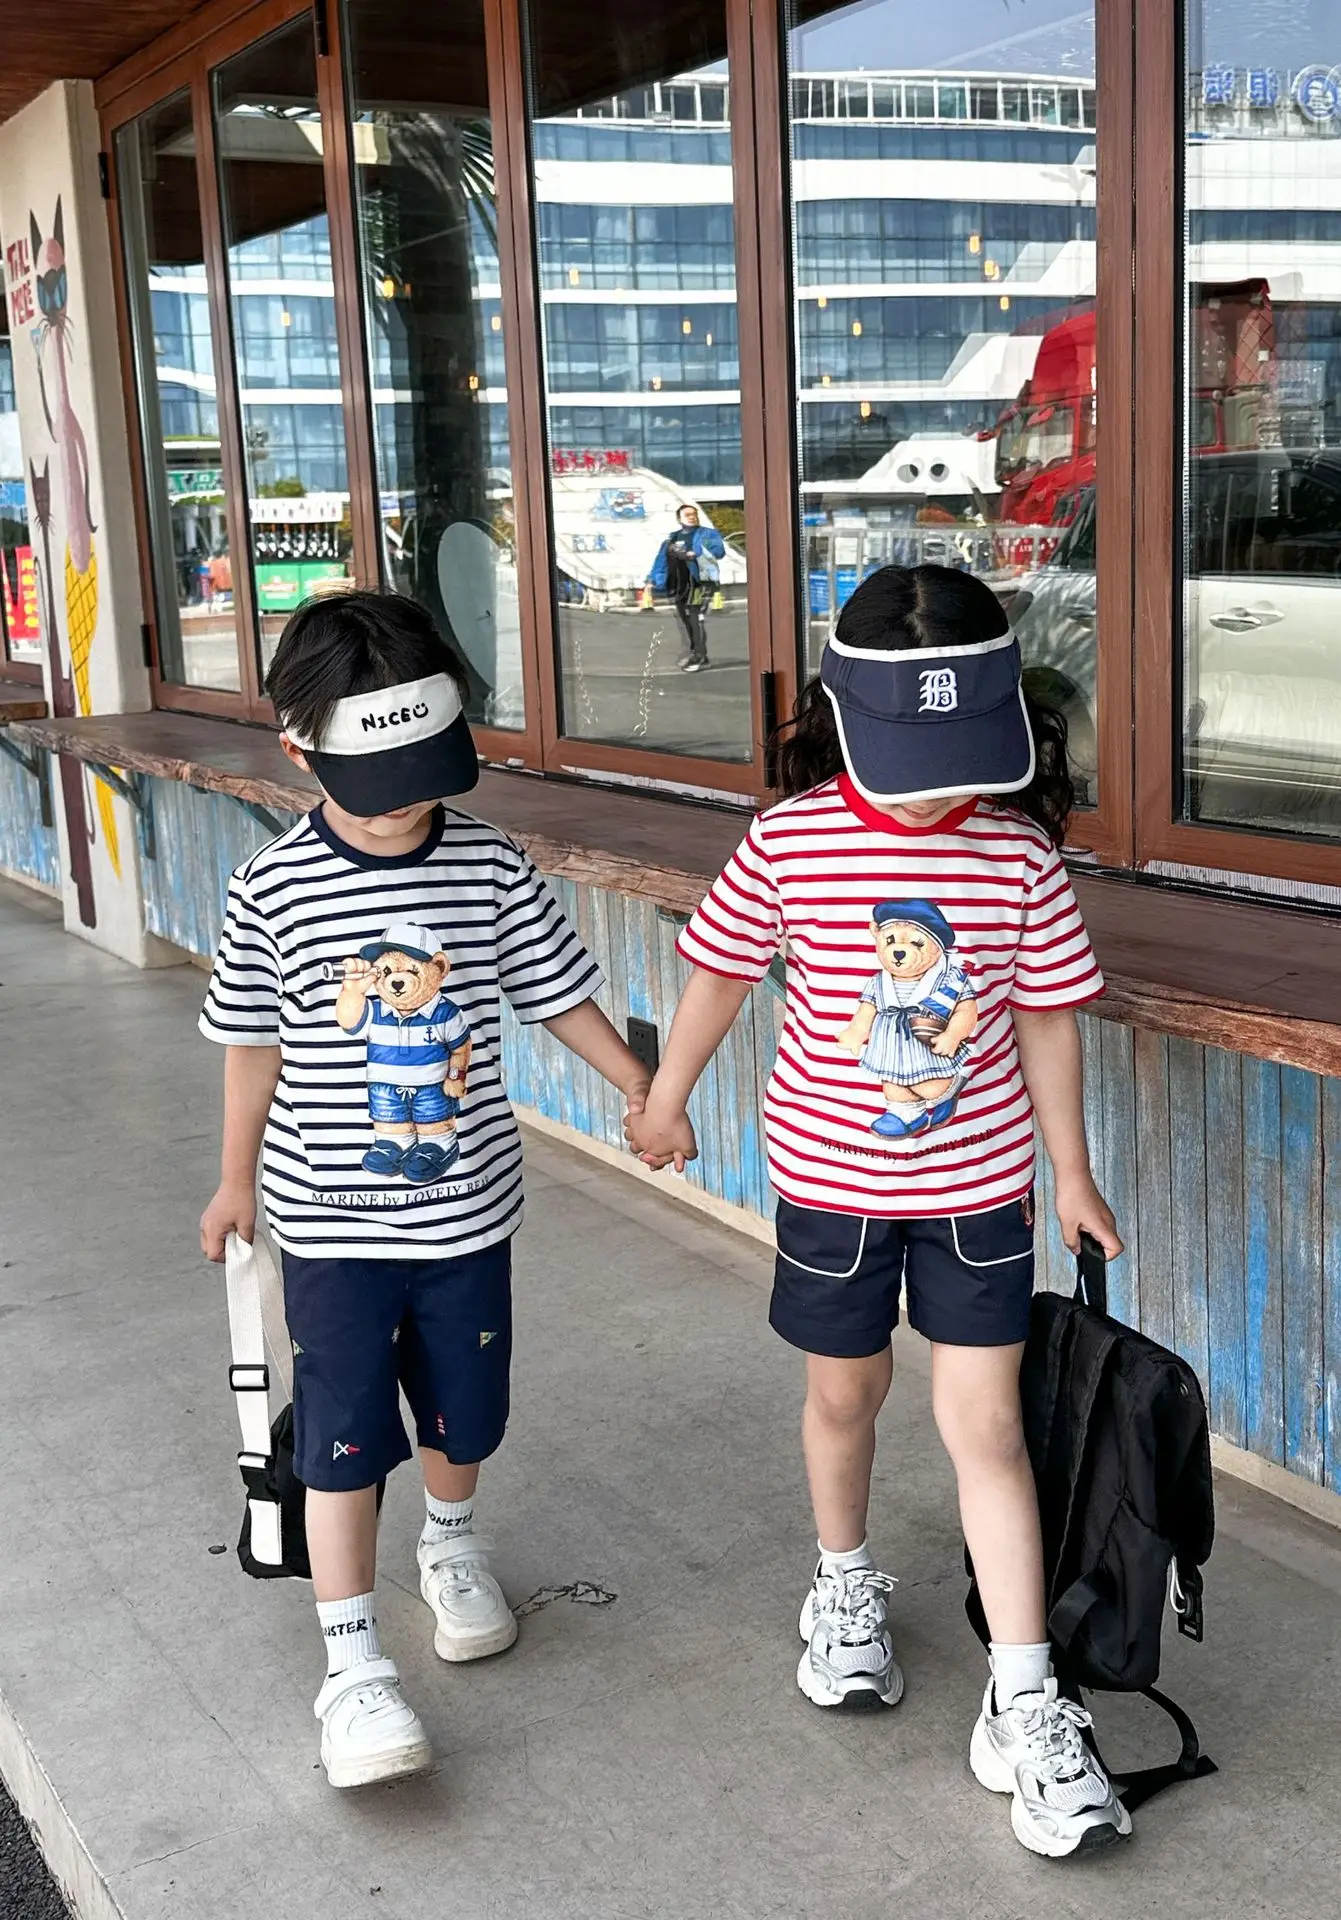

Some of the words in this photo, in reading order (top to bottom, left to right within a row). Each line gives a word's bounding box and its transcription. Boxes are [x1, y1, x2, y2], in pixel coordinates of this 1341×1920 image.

[361, 707, 411, 732] NICE
[820, 1137, 879, 1159] MARINE
[311, 1192, 379, 1207] MARINE
[383, 1193, 400, 1207] by
